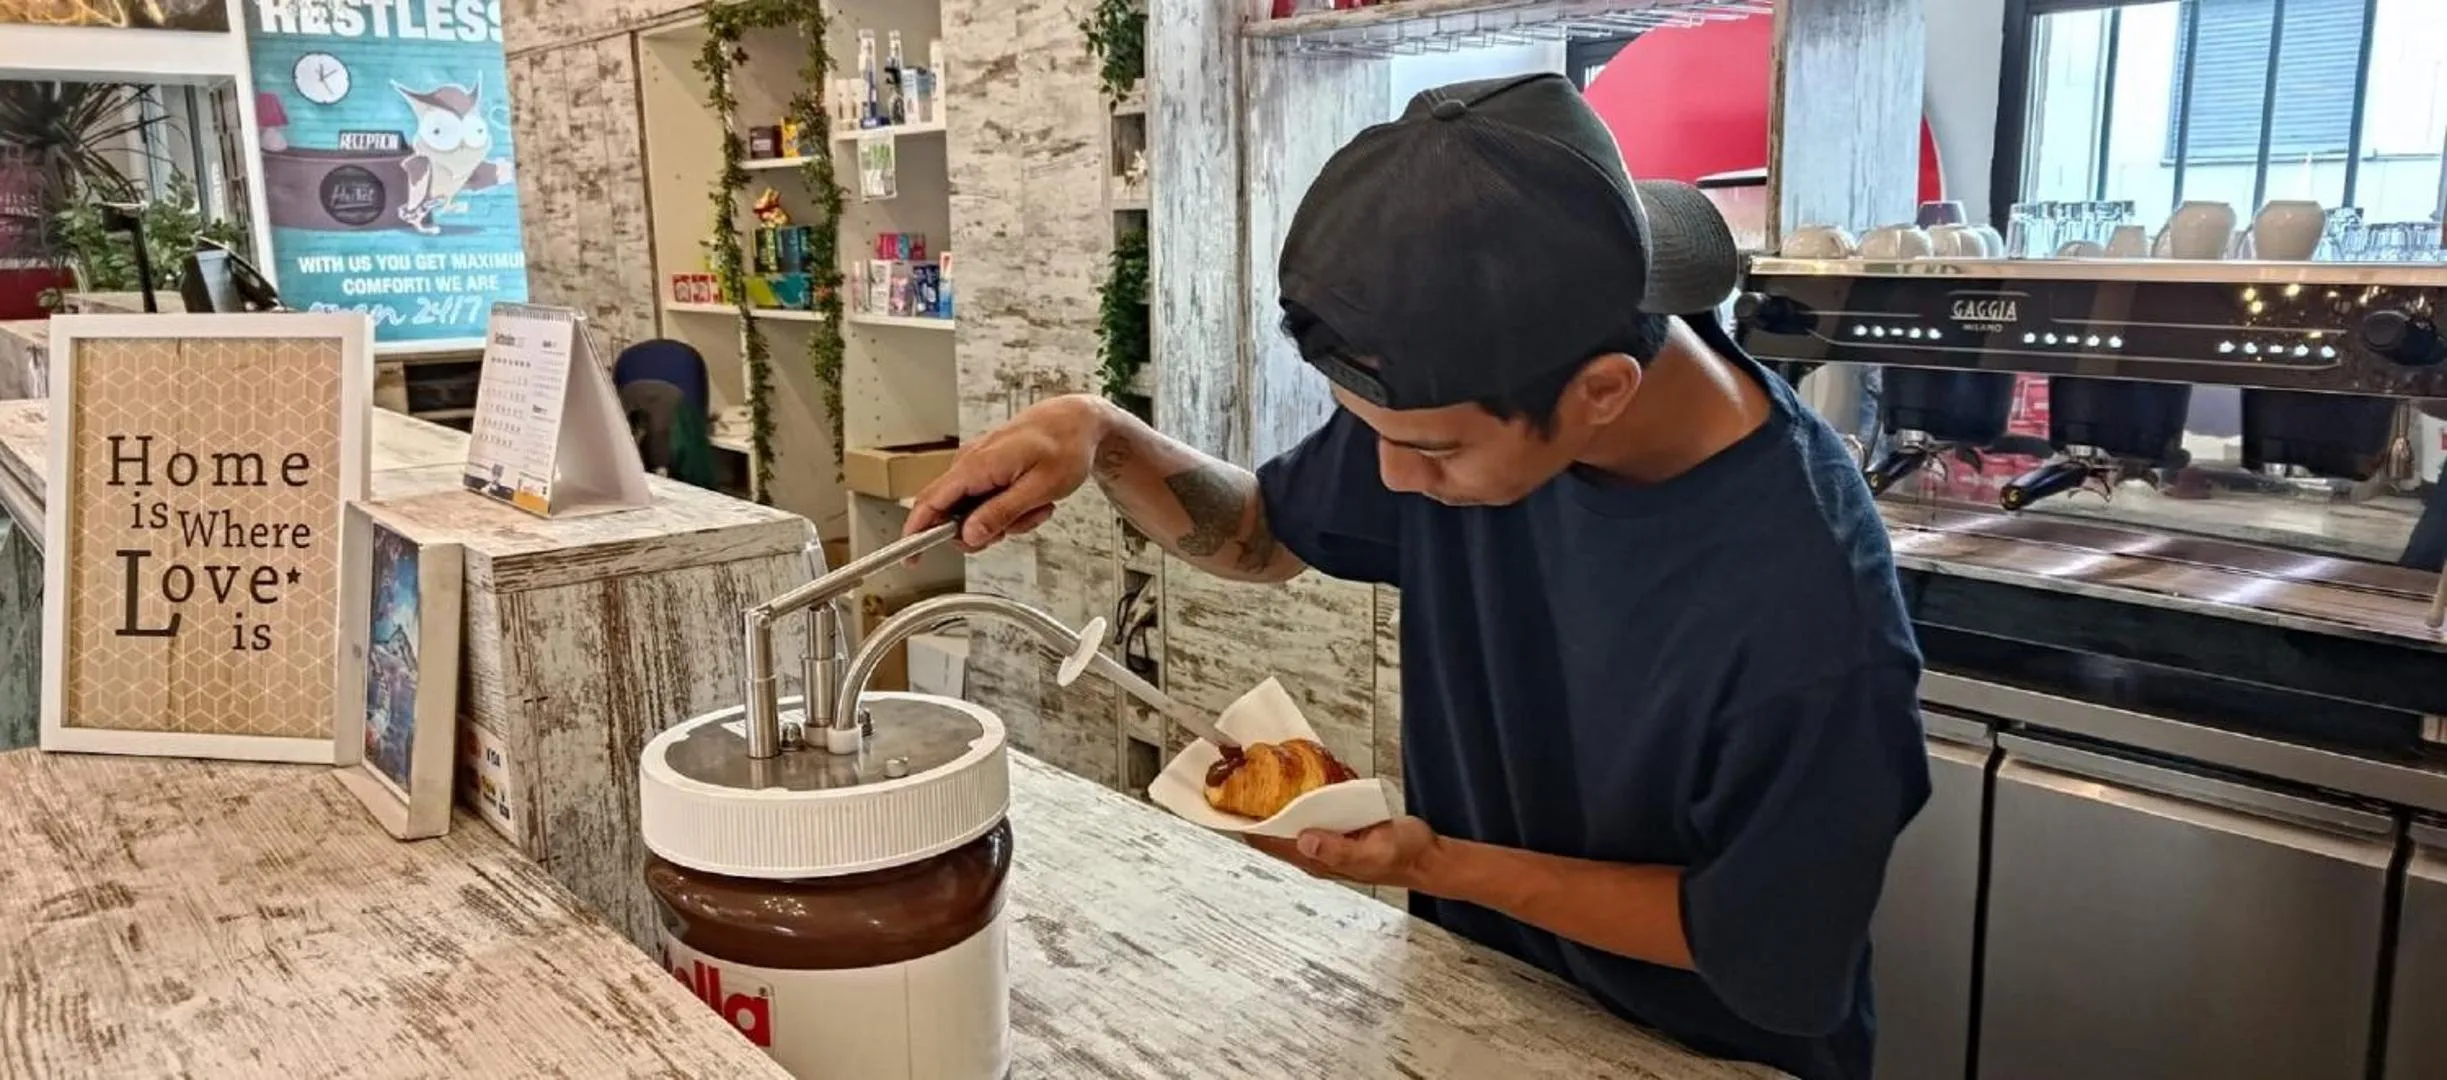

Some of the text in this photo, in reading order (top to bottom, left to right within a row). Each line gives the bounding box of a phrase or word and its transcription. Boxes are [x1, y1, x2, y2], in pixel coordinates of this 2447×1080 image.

[340, 132, 399, 150] RECEPTION
[298, 255, 345, 273] WITH
[348, 255, 373, 272] US
[376, 254, 411, 271] YOU
[416, 253, 447, 271] GET
[435, 275, 462, 293] WE
[466, 274, 499, 292] ARE
[1952, 300, 2018, 321] GAGGIA
[106, 435, 311, 487] Home
[130, 491, 311, 549] is Where
[115, 549, 280, 637] Love
[231, 612, 272, 651] is
